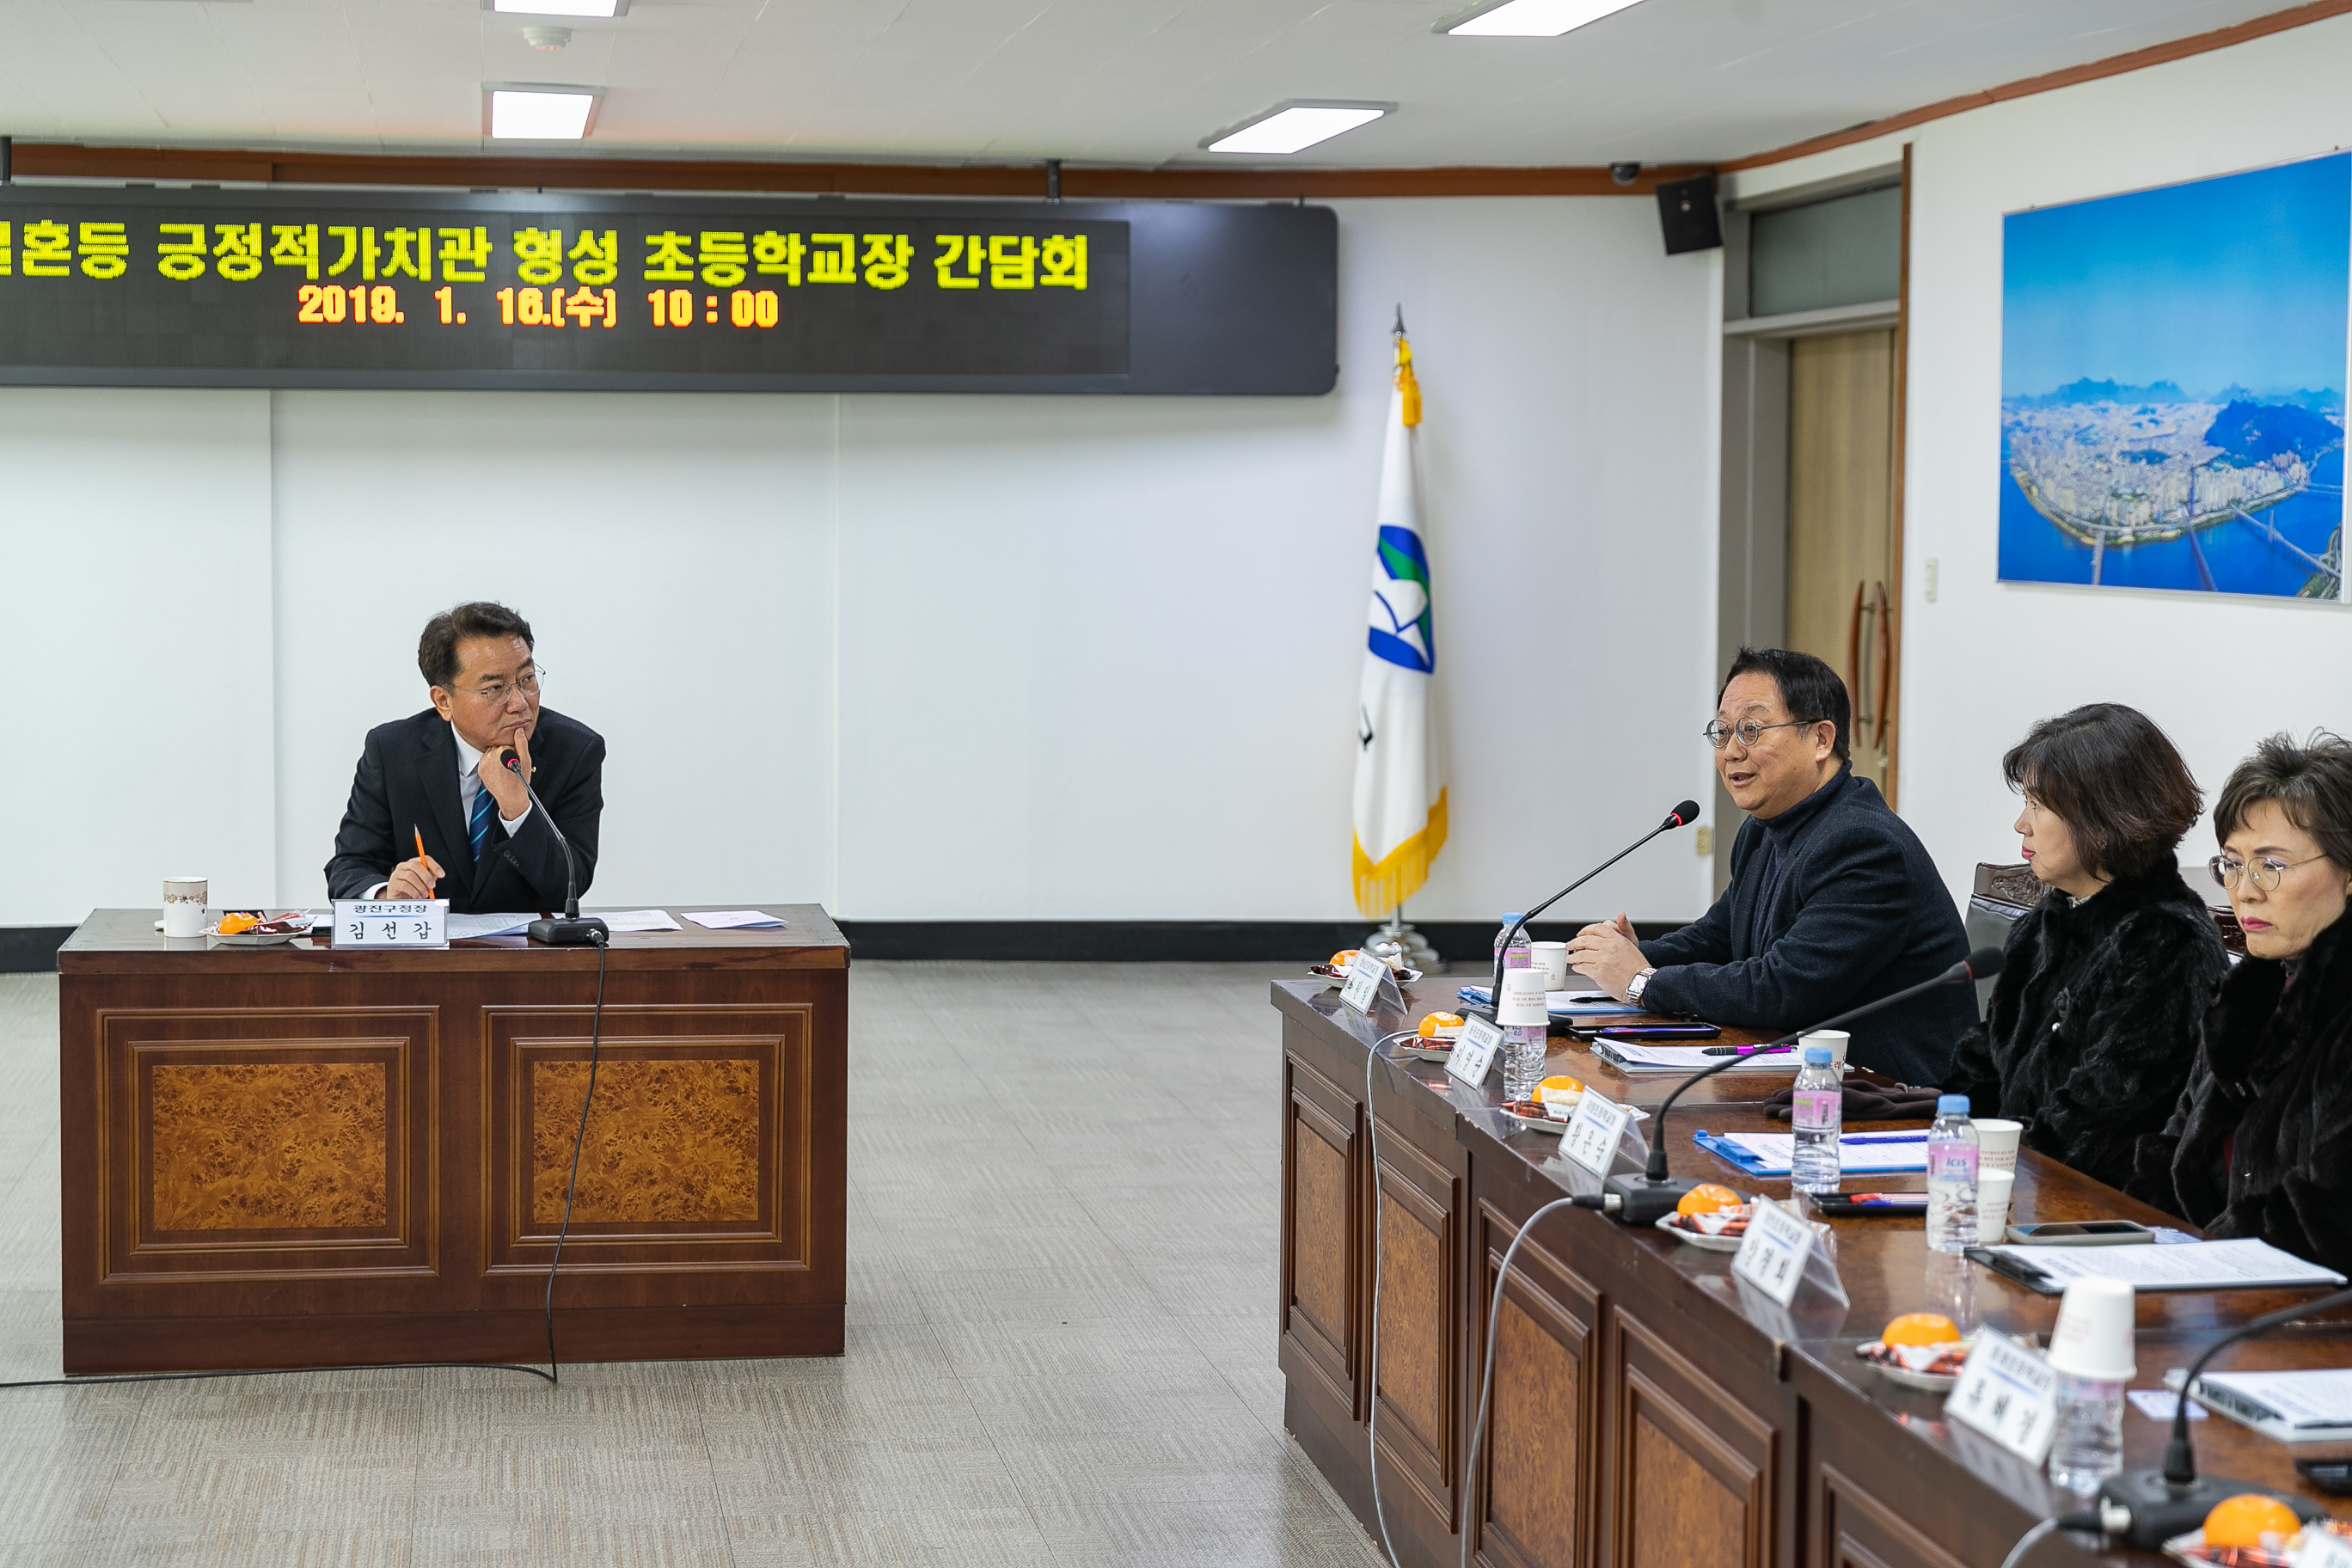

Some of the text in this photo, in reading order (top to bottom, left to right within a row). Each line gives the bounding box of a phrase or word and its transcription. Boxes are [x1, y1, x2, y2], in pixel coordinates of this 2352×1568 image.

[0, 219, 1088, 291] 혼등 긍정적가치관 형성 초등학교장 간담회
[297, 285, 405, 324] 2019.
[434, 285, 467, 325] 1.
